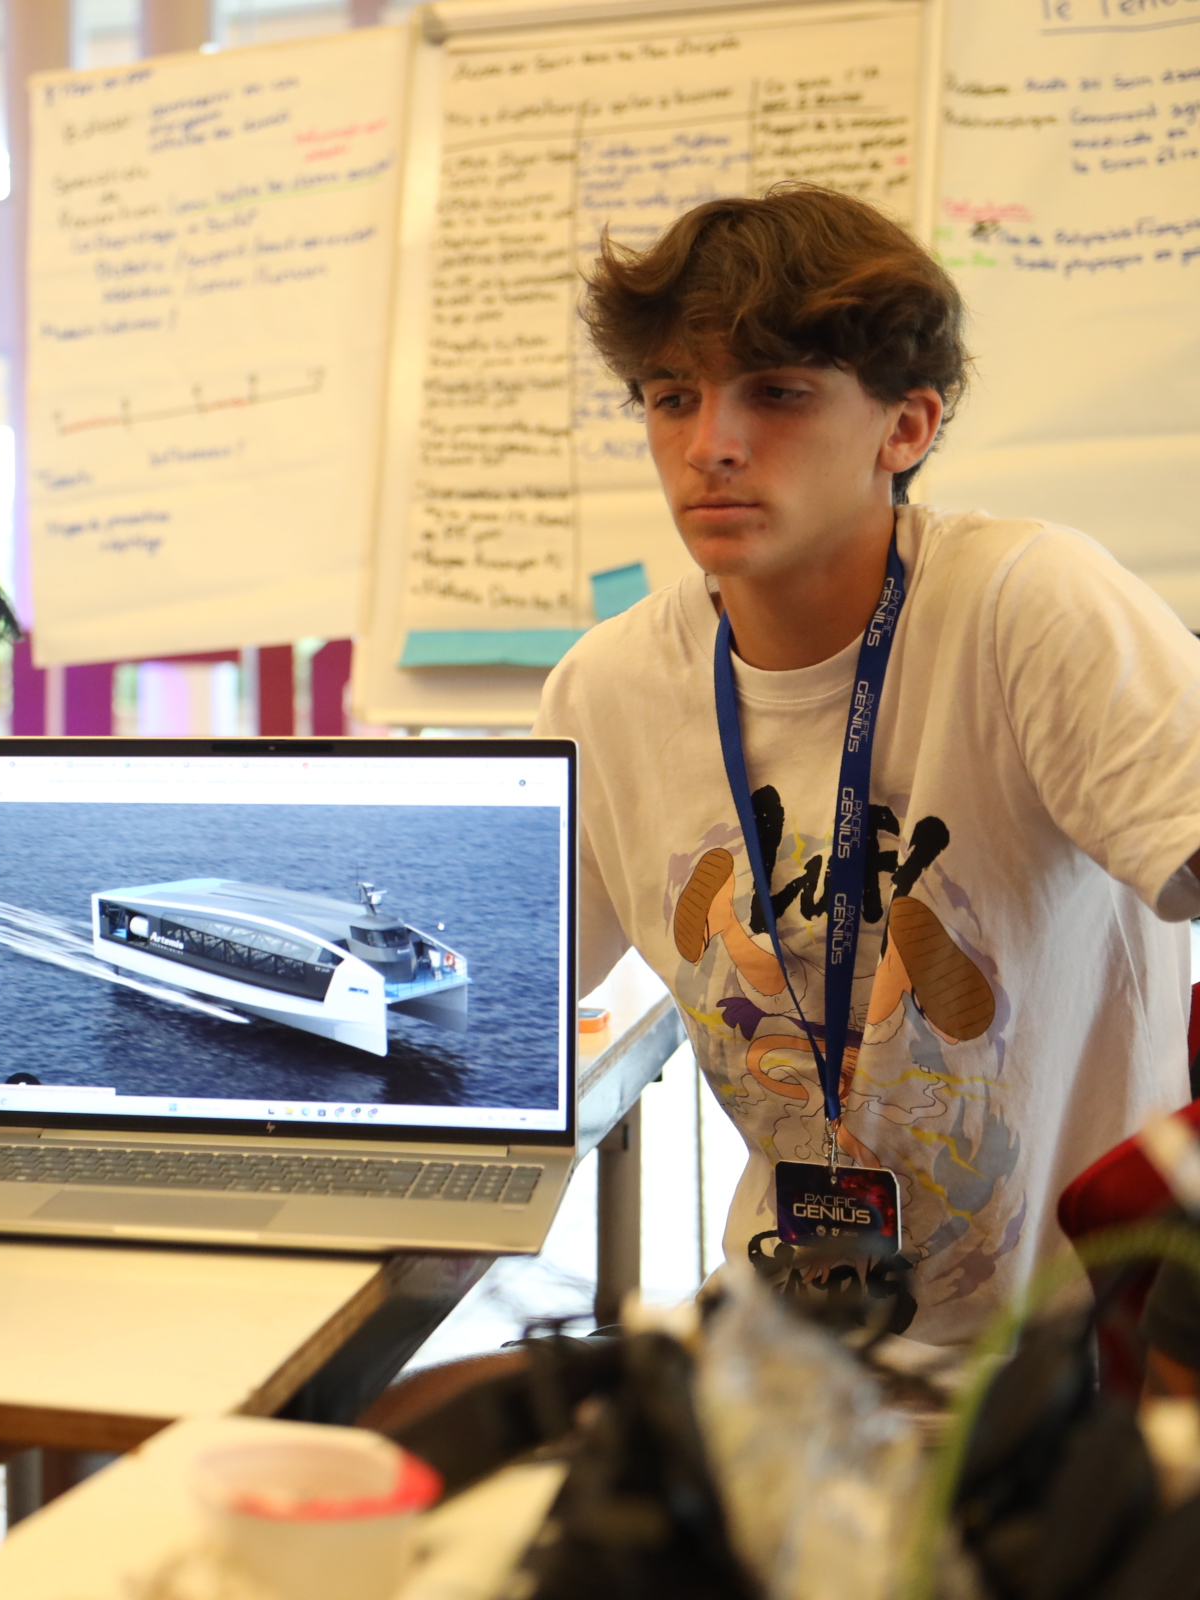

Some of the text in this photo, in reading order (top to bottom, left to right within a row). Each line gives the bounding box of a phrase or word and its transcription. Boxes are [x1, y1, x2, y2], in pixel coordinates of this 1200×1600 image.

[867, 577, 895, 647] GENIUS
[881, 588, 901, 637] PACIFIC
[847, 680, 869, 753] GENIUS
[860, 693, 876, 742] PACIFIC
[837, 787, 855, 859] GENIUS
[850, 800, 863, 849] PACIFIC
[150, 931, 185, 950] Artemis
[830, 893, 847, 965] GENIUS
[843, 905, 856, 953] PACIFIC
[792, 1203, 871, 1225] GENIUS
[804, 1193, 858, 1210] PACIFIC
